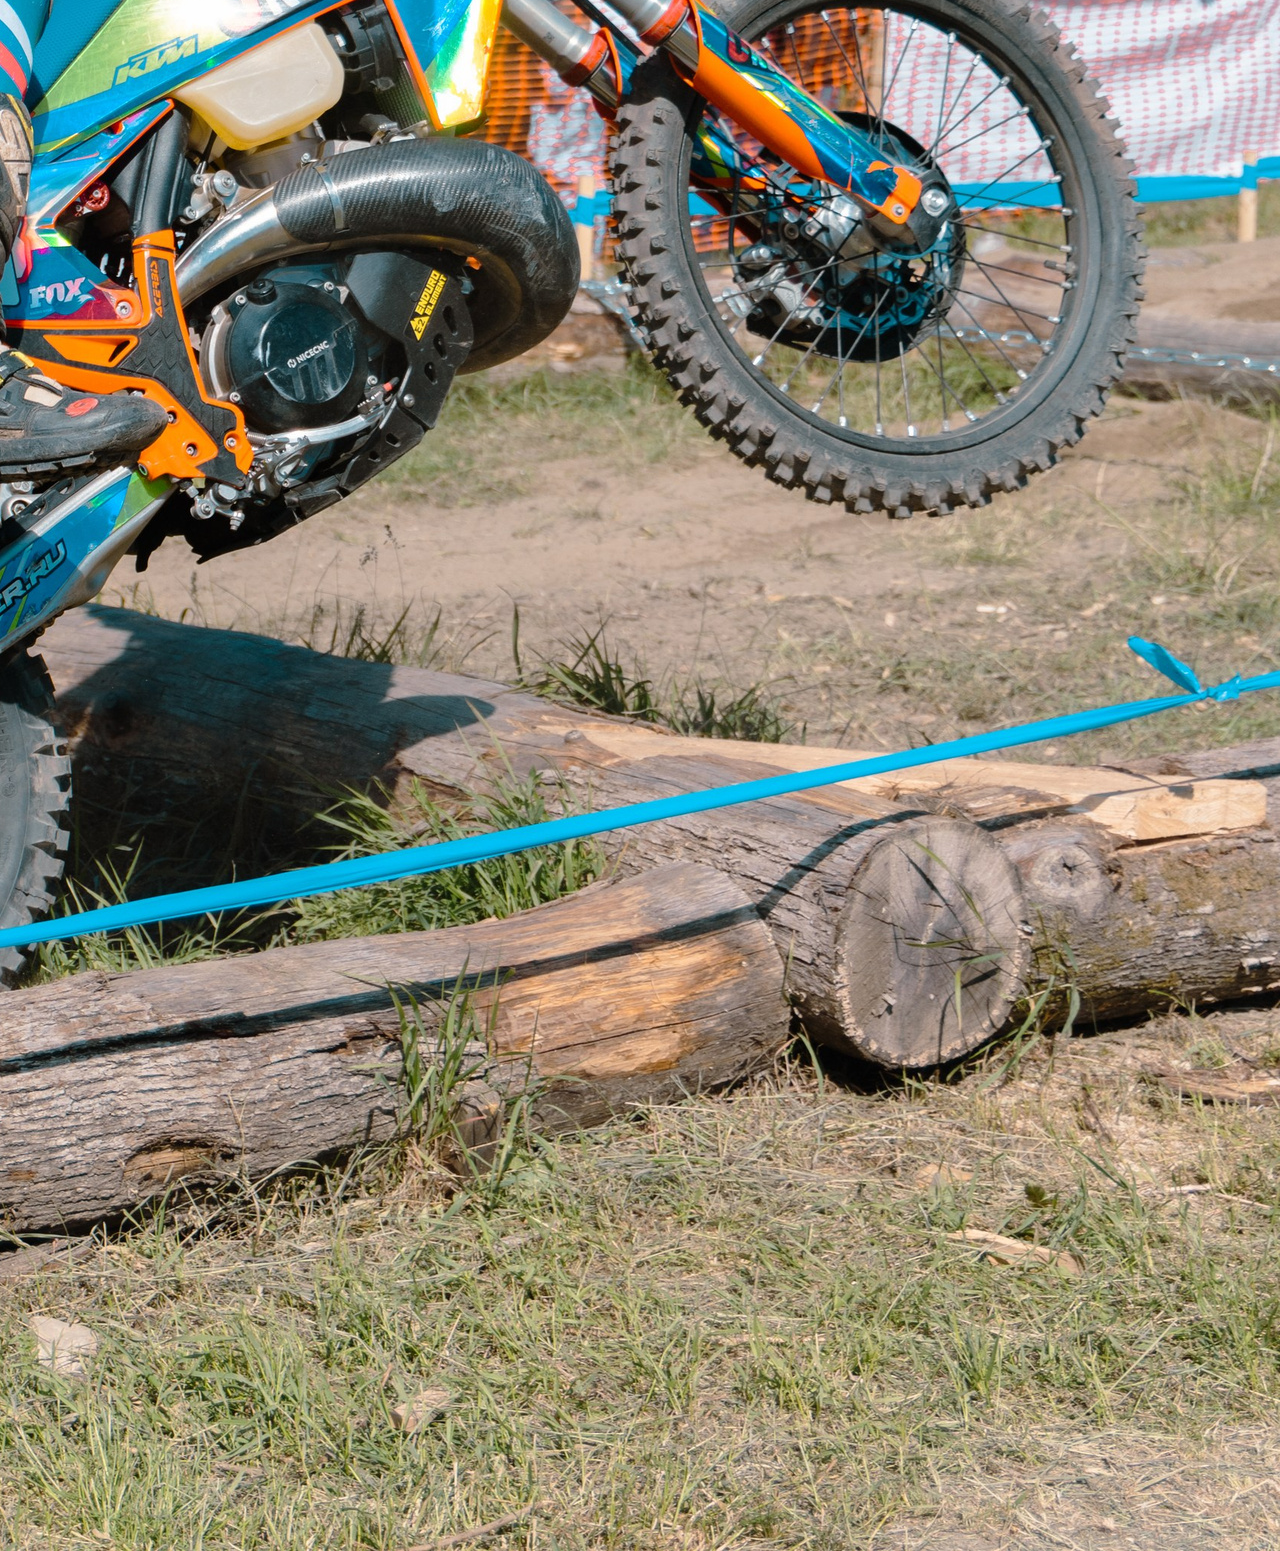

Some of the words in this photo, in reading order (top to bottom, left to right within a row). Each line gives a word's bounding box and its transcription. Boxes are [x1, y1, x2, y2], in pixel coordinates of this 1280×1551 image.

[114, 36, 197, 87] KTM
[29, 277, 86, 309] FOX
[150, 259, 164, 319] ACERBIS
[415, 269, 441, 316] ENDURO
[424, 274, 448, 316] ELEMENT
[295, 340, 330, 364] NICECNC
